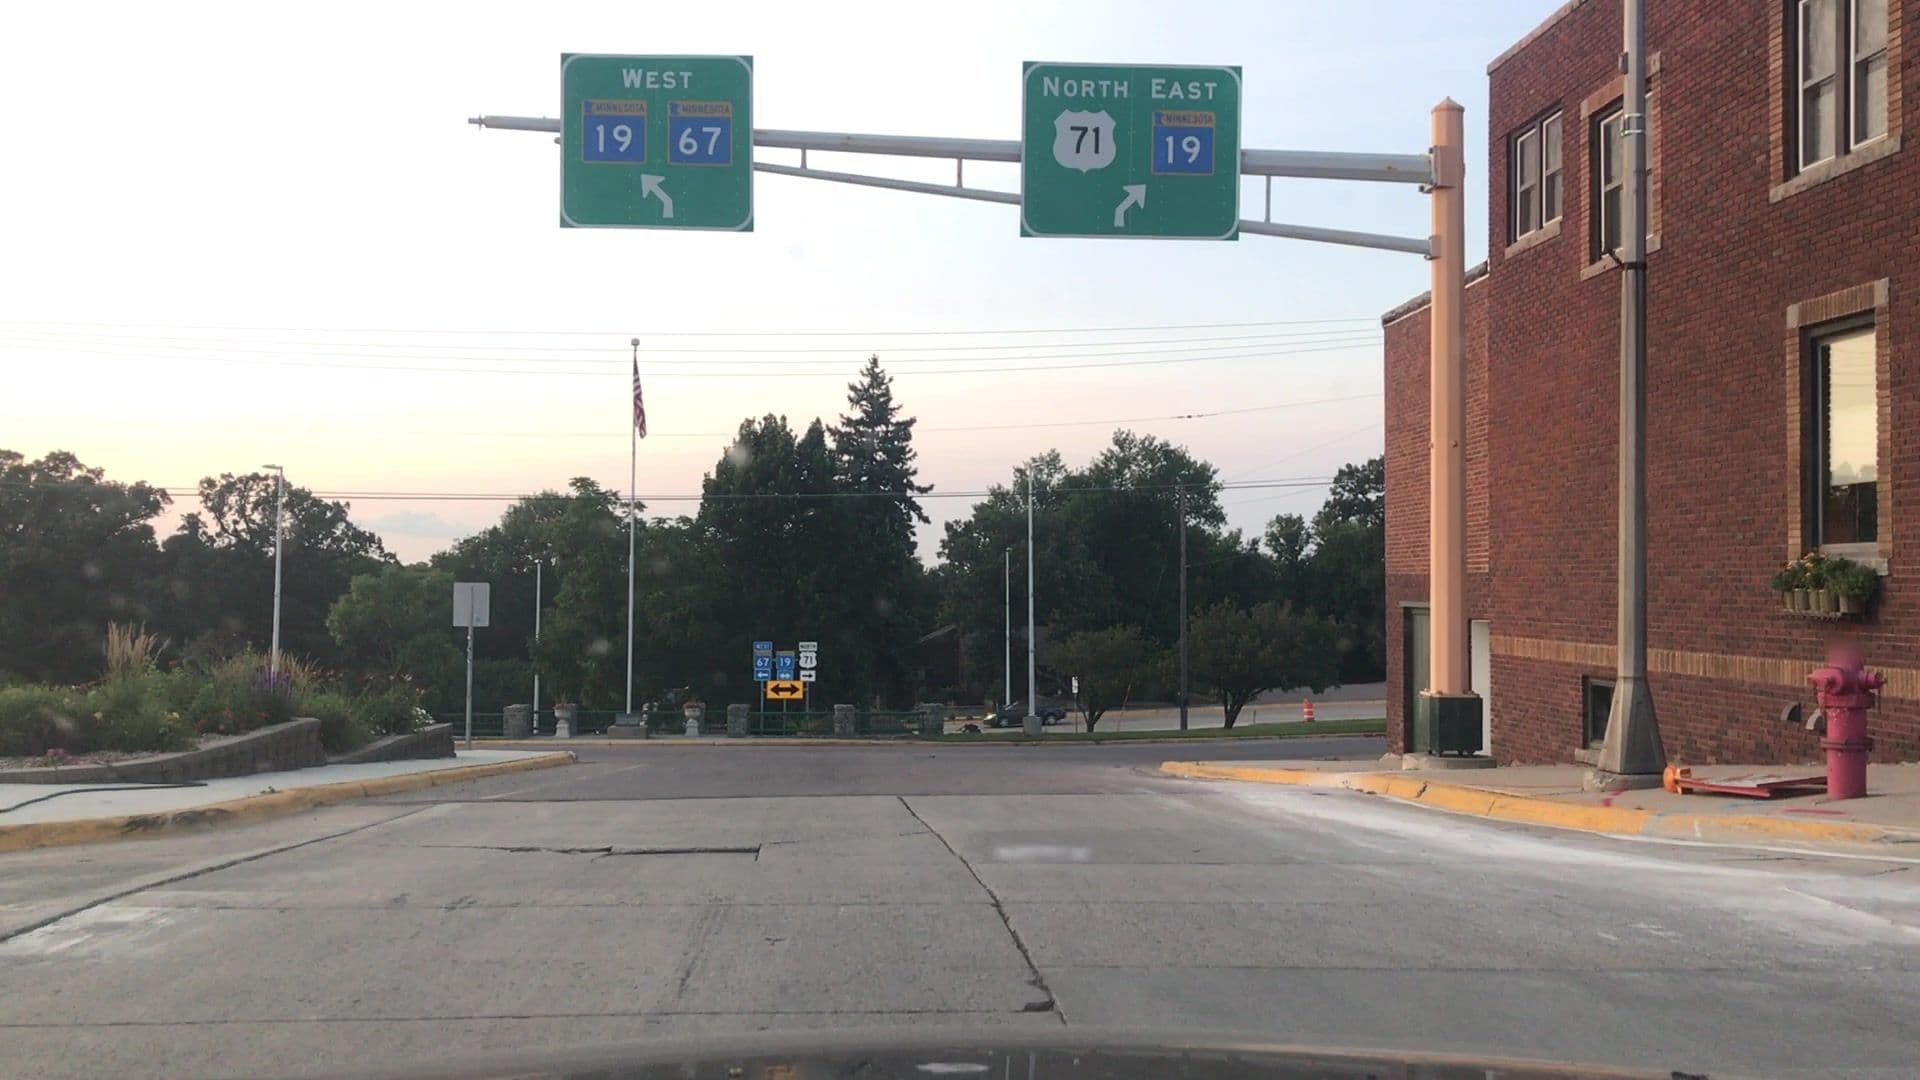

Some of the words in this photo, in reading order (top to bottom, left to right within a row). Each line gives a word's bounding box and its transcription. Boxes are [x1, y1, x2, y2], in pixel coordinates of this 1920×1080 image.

[622, 69, 693, 88] WEST
[1043, 77, 1128, 98] NORTH
[1151, 78, 1217, 100] EAST
[596, 102, 645, 113] MINNESOTA
[682, 104, 730, 113] MINNESOTA
[1165, 113, 1214, 124] MINNESOTA
[596, 124, 633, 152] 19
[678, 127, 721, 155] 67
[1070, 126, 1100, 154] 71
[1166, 136, 1201, 164] 19
[757, 658, 769, 666] 67
[780, 658, 791, 666] 19
[804, 656, 813, 664] 71
